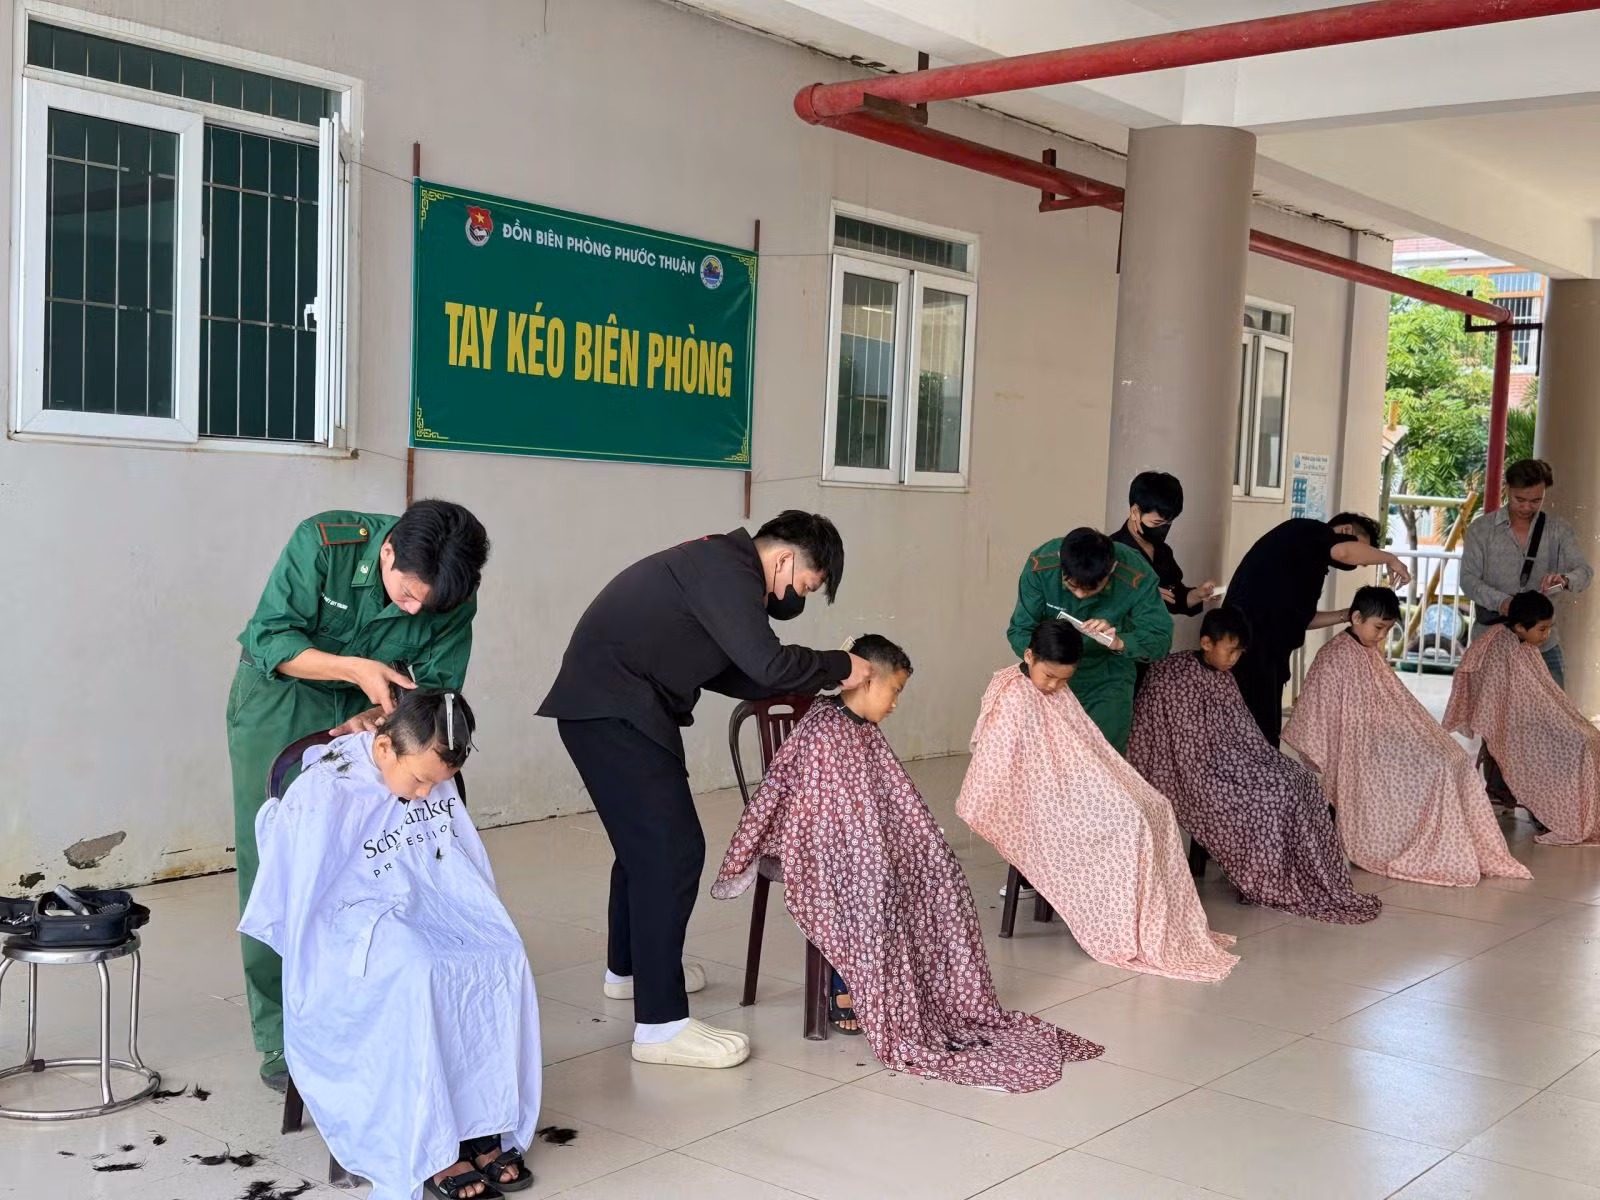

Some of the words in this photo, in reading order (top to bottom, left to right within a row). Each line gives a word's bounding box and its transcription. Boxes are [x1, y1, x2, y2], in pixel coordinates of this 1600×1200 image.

[502, 219, 532, 243] ĐỒN
[536, 229, 563, 249] BIÊN
[566, 236, 612, 258] PHÒNG
[614, 247, 656, 267] PHƯỚC
[658, 255, 696, 277] THUẬN
[444, 301, 498, 370] TAY
[507, 302, 565, 379] KÉO
[574, 313, 640, 387] BIÊN
[647, 324, 733, 397] PHÒNG
